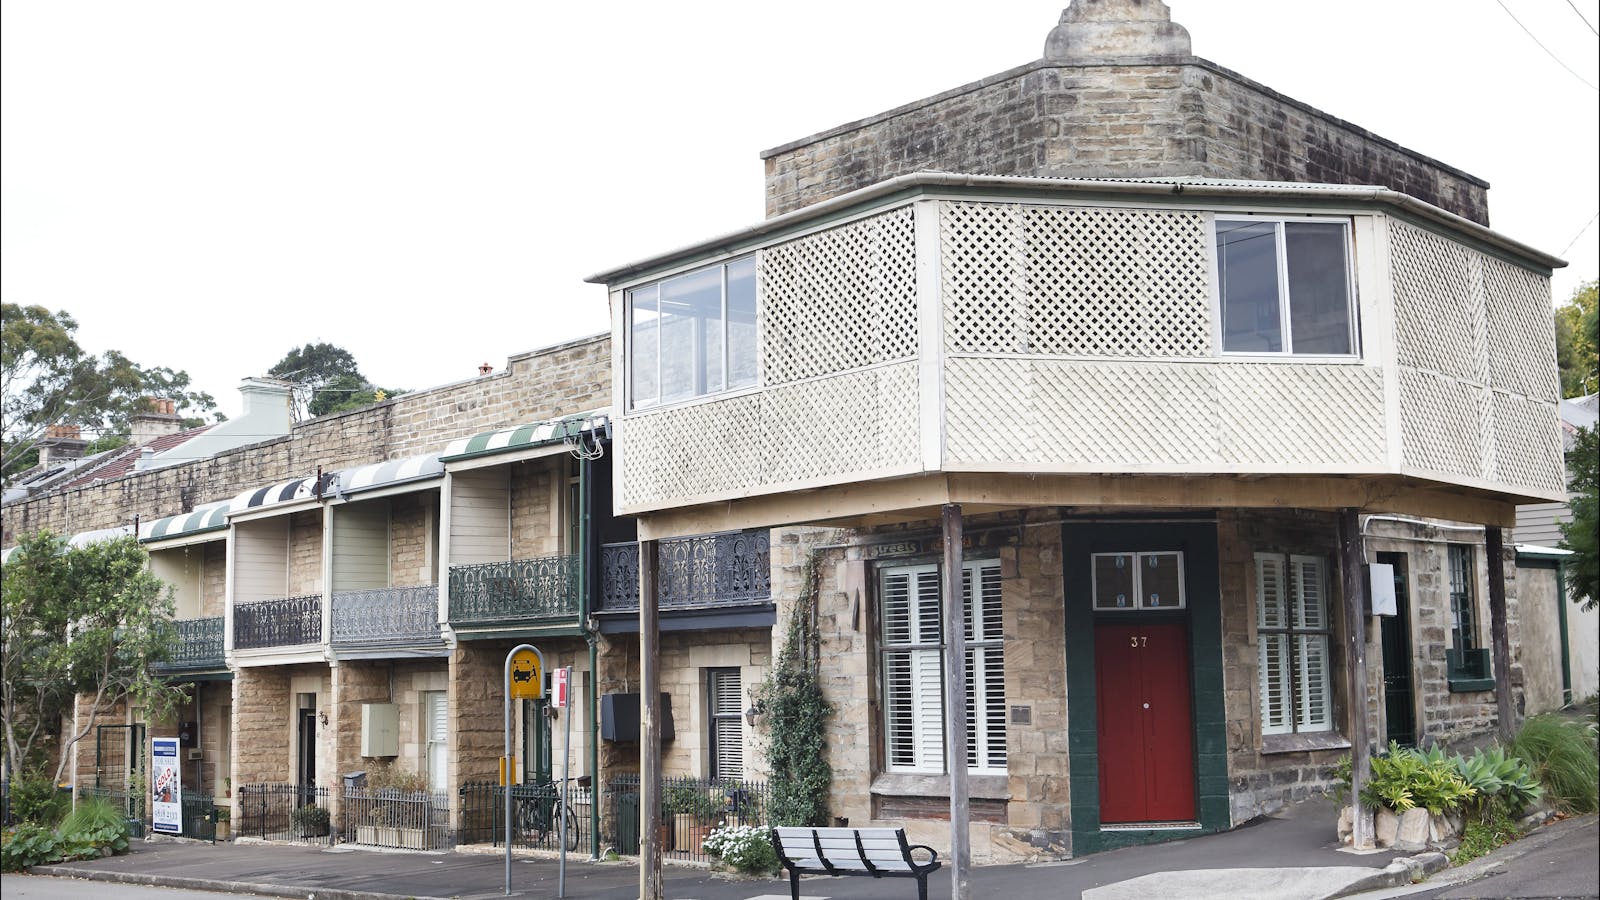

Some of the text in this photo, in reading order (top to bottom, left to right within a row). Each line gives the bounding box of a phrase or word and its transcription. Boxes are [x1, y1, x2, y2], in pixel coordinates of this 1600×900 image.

[870, 540, 917, 557] Streets
[1131, 636, 1147, 648] 37
[157, 767, 171, 789] SOLD
